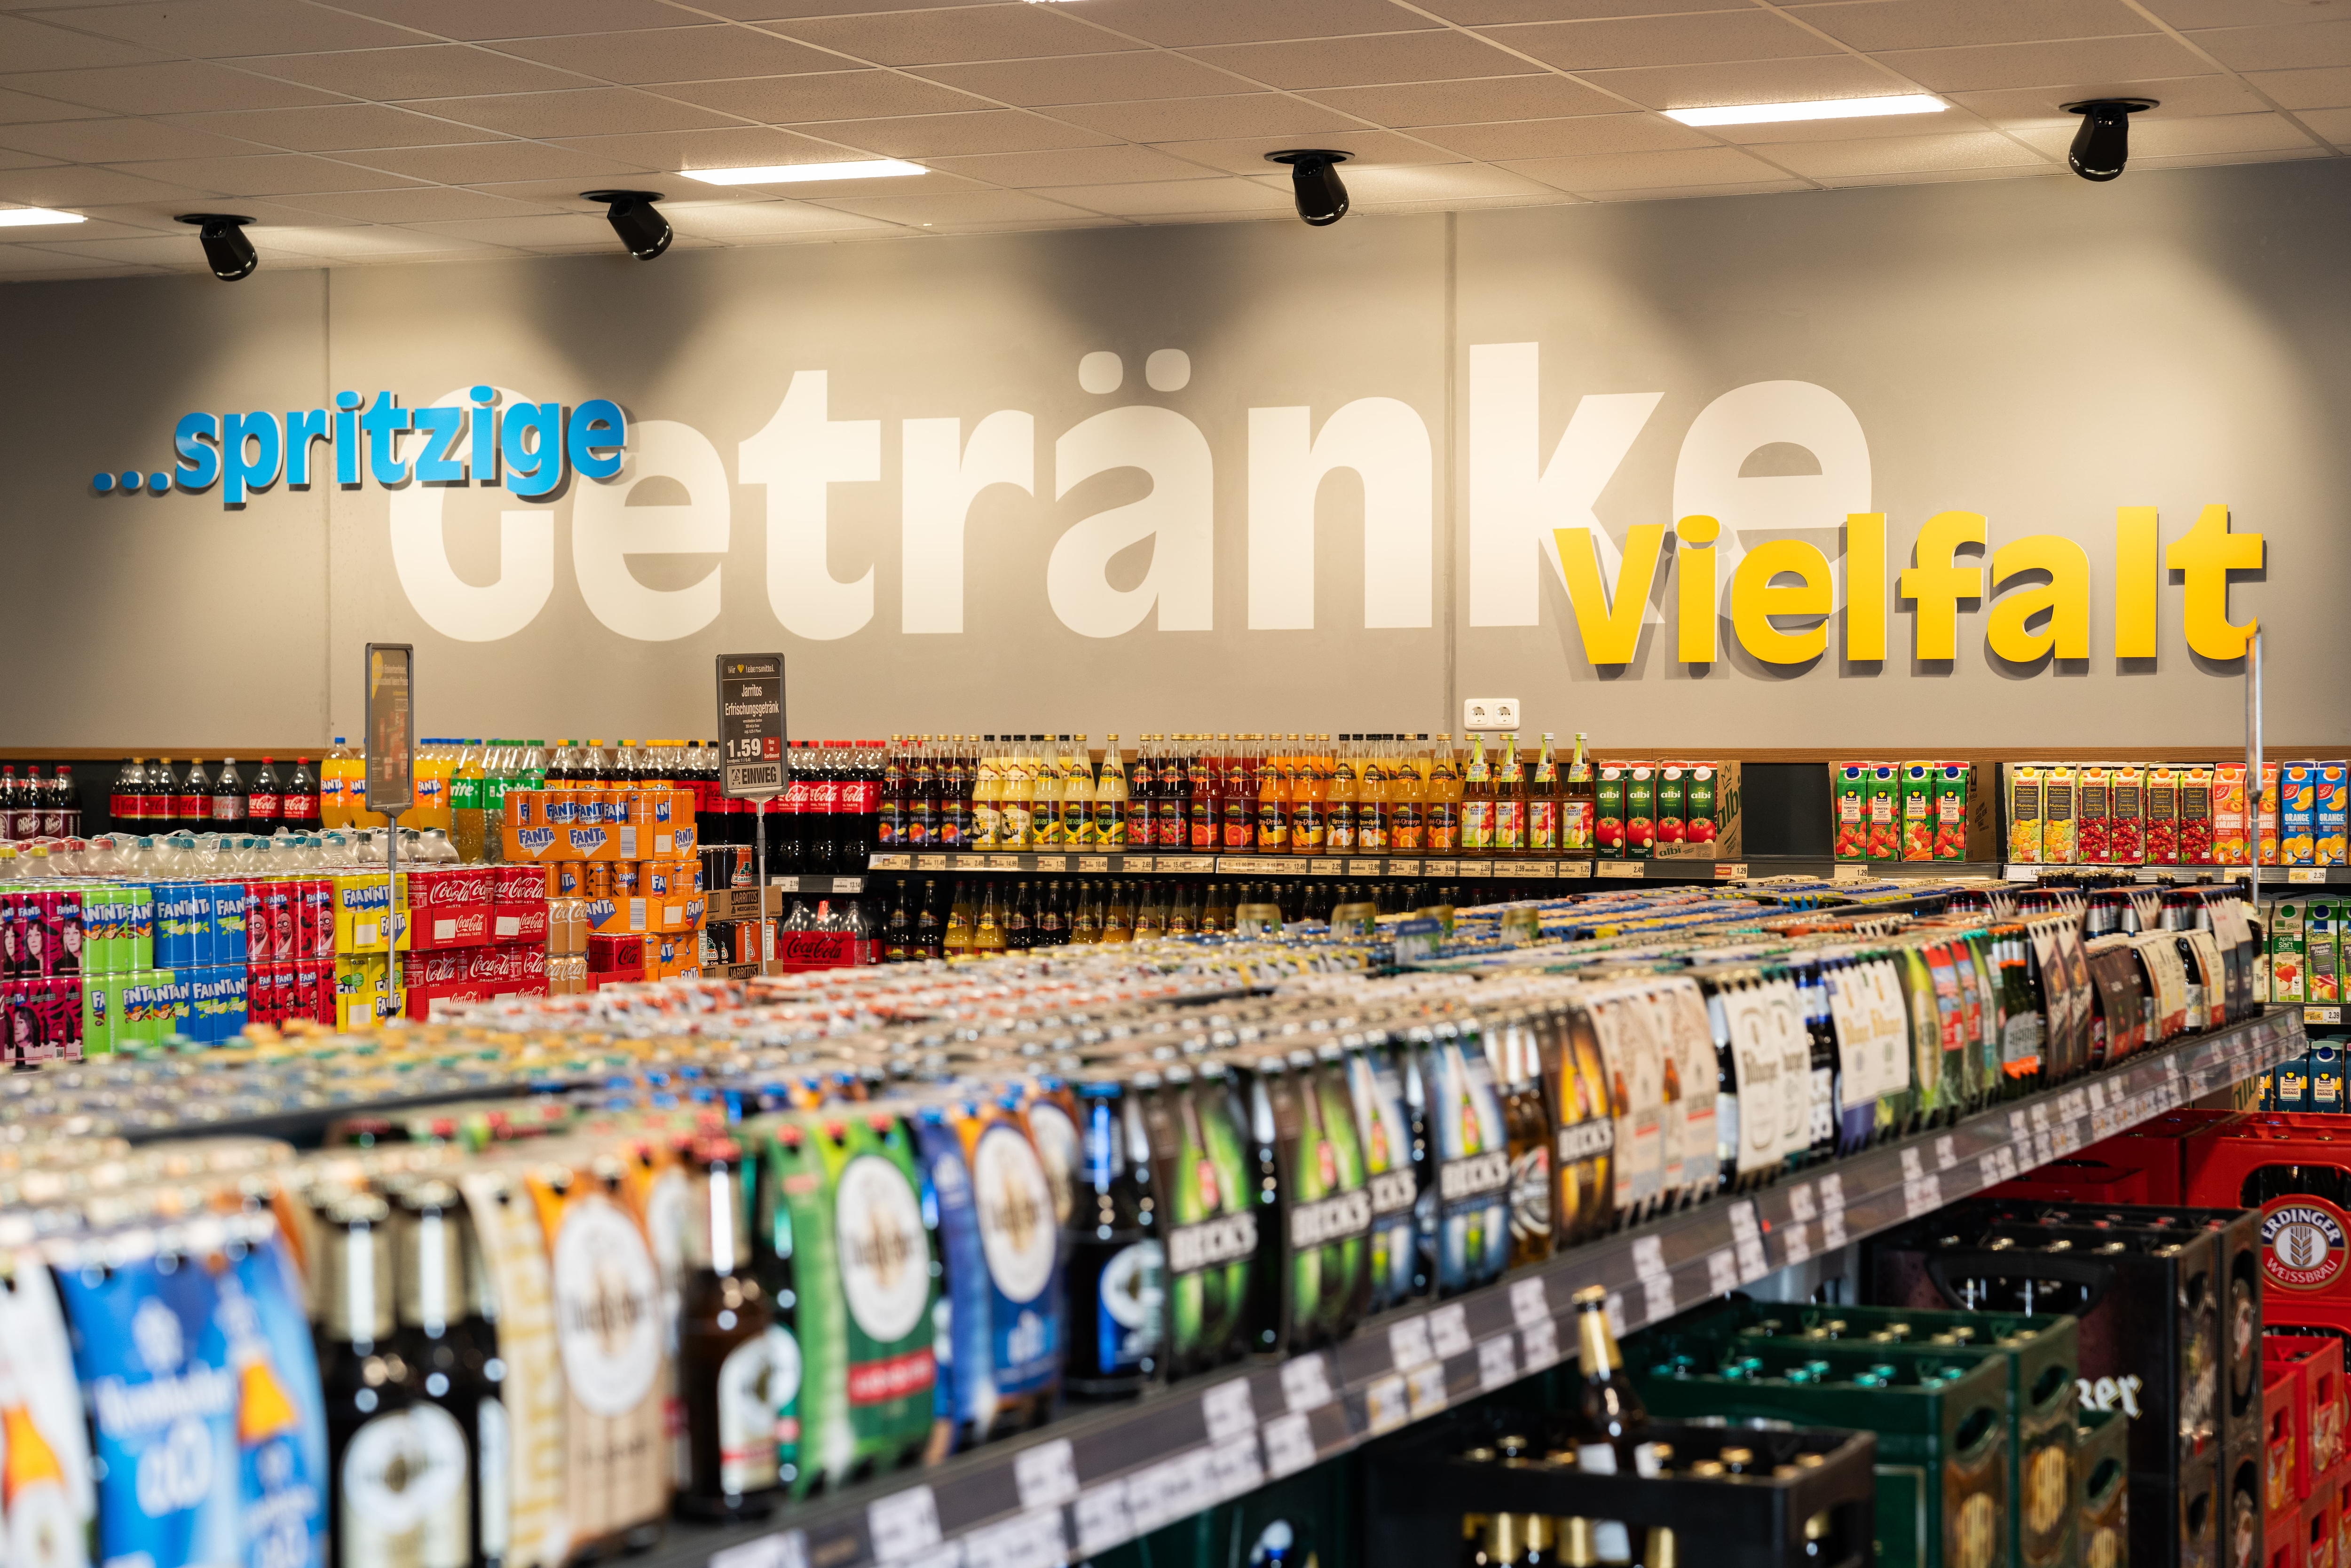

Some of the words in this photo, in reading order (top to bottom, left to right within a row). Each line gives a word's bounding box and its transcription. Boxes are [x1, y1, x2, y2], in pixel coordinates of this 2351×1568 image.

[388, 342, 1873, 642] Getränke
[746, 664, 774, 673] Lebensmittel.
[742, 684, 762, 697] Jarritos
[725, 701, 779, 717] Erfrischungsgetränk
[727, 738, 761, 757] 1.59
[742, 766, 776, 784] EINWEG
[418, 779, 442, 791] FANTA
[518, 827, 555, 844] FANTA
[570, 827, 607, 844] FANTA
[675, 827, 694, 845] FANTA
[1659, 846, 1681, 857] albi
[732, 891, 757, 904] JARRITOS
[2261, 1209, 2341, 1243] ERDINGER
[2267, 1258, 2337, 1283] WEISSBRÄU
